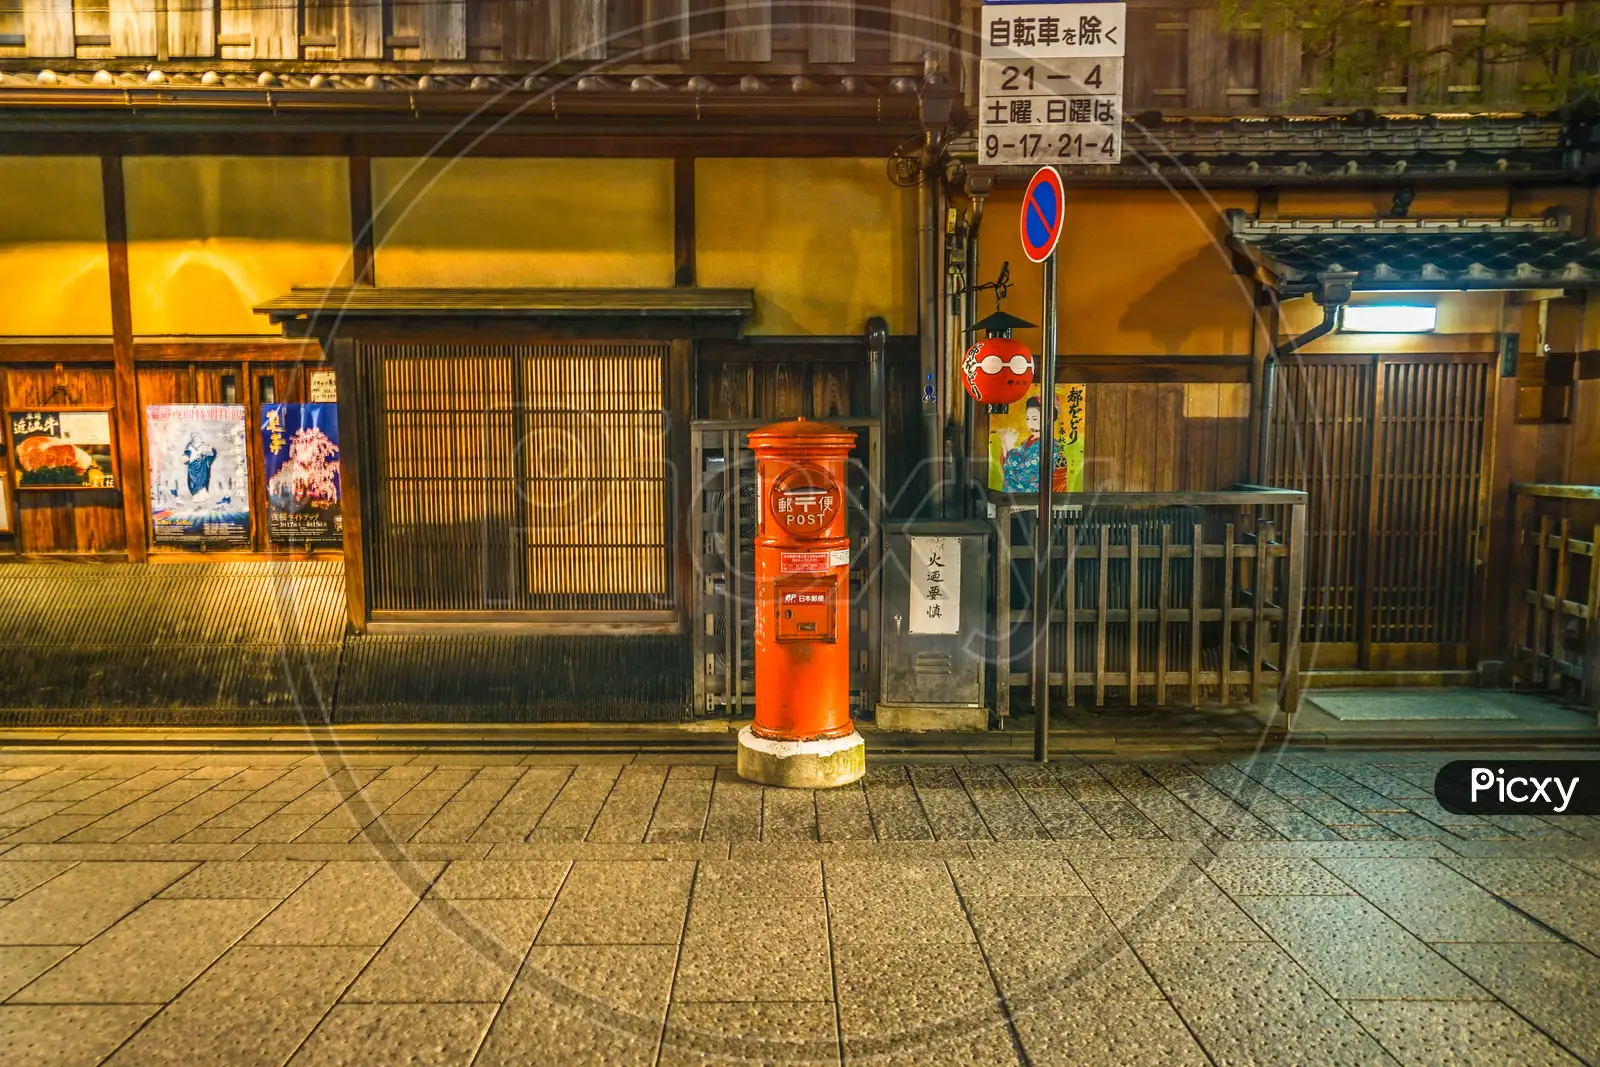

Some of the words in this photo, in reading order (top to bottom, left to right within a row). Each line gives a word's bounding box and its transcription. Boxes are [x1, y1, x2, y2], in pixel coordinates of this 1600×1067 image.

[990, 15, 1117, 47] 自転車を除く
[986, 99, 1115, 124] 土曜、日曜は
[13, 415, 59, 436] 近江牛
[1066, 386, 1084, 446] 都をどり
[786, 513, 826, 526] POST
[798, 594, 825, 603] 日本郵便
